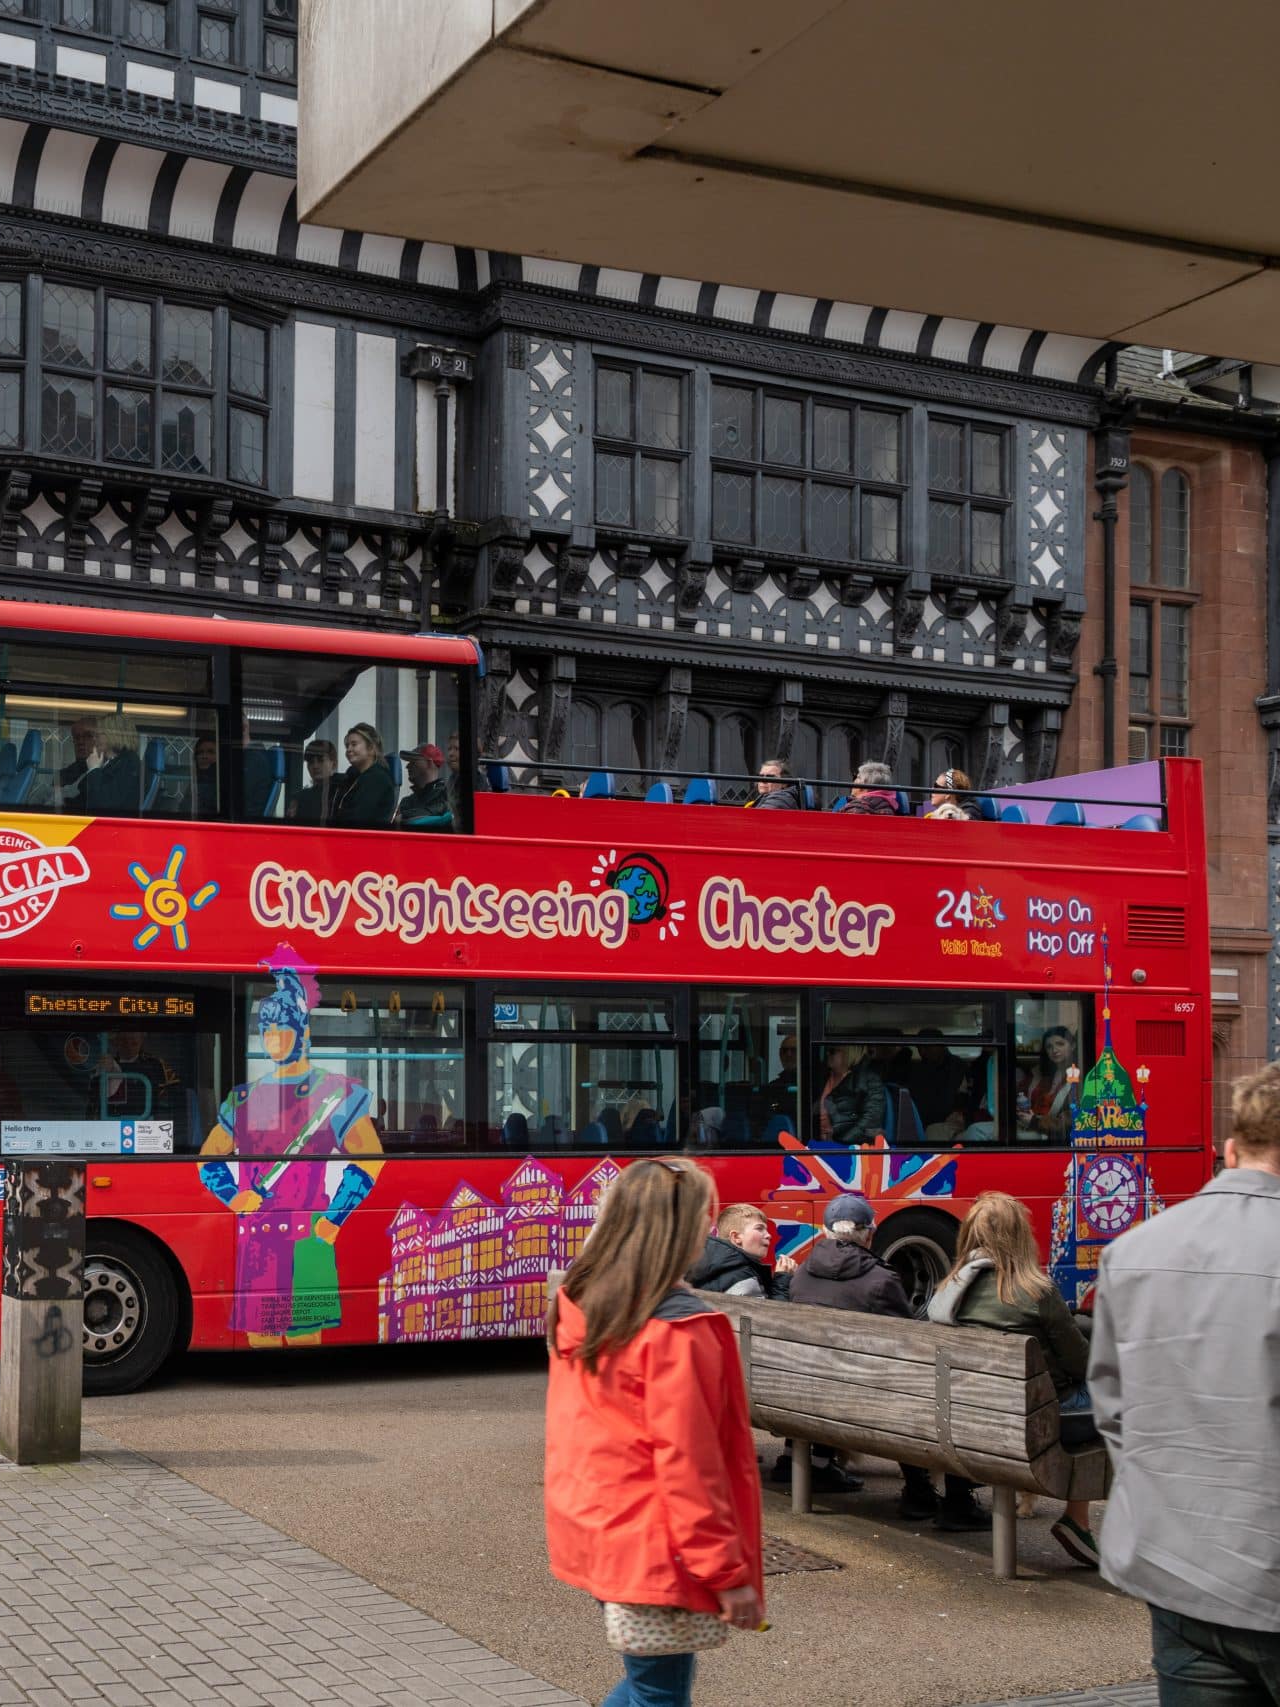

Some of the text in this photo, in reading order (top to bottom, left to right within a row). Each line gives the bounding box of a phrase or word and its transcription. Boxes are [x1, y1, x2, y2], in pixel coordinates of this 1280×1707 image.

[698, 876, 895, 957] Chester
[935, 889, 972, 928] 24
[1028, 898, 1092, 924] Hop On
[940, 939, 1003, 957] Valid Ticket
[1028, 931, 1095, 956] Hop Off
[29, 995, 194, 1015] Chester City Sig
